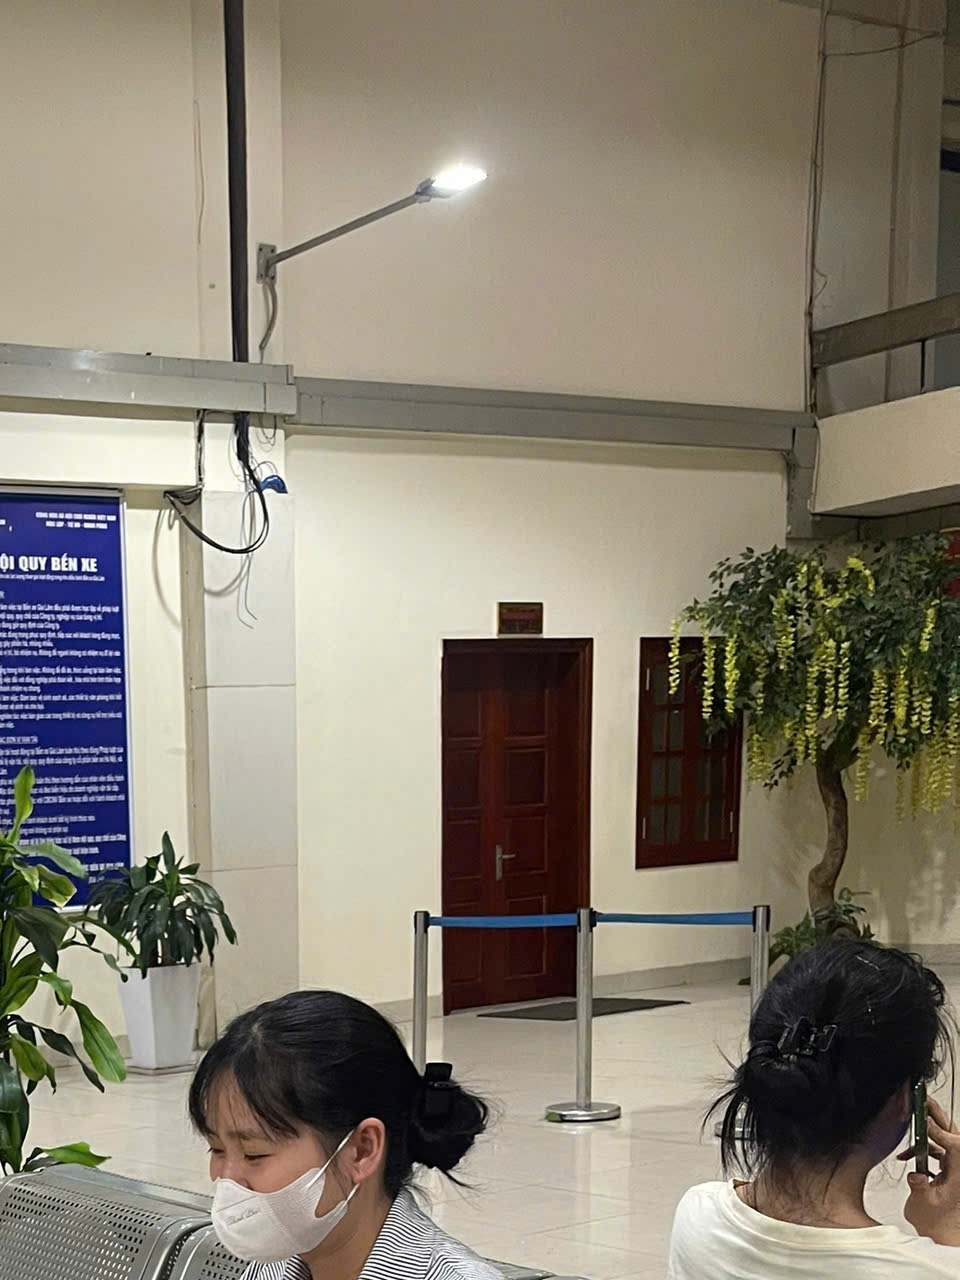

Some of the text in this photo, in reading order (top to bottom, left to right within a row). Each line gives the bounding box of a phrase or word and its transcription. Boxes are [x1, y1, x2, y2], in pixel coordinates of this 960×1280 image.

[18, 555, 47, 572] QUY
[50, 552, 78, 572] BẾN
[81, 557, 98, 572] XE
